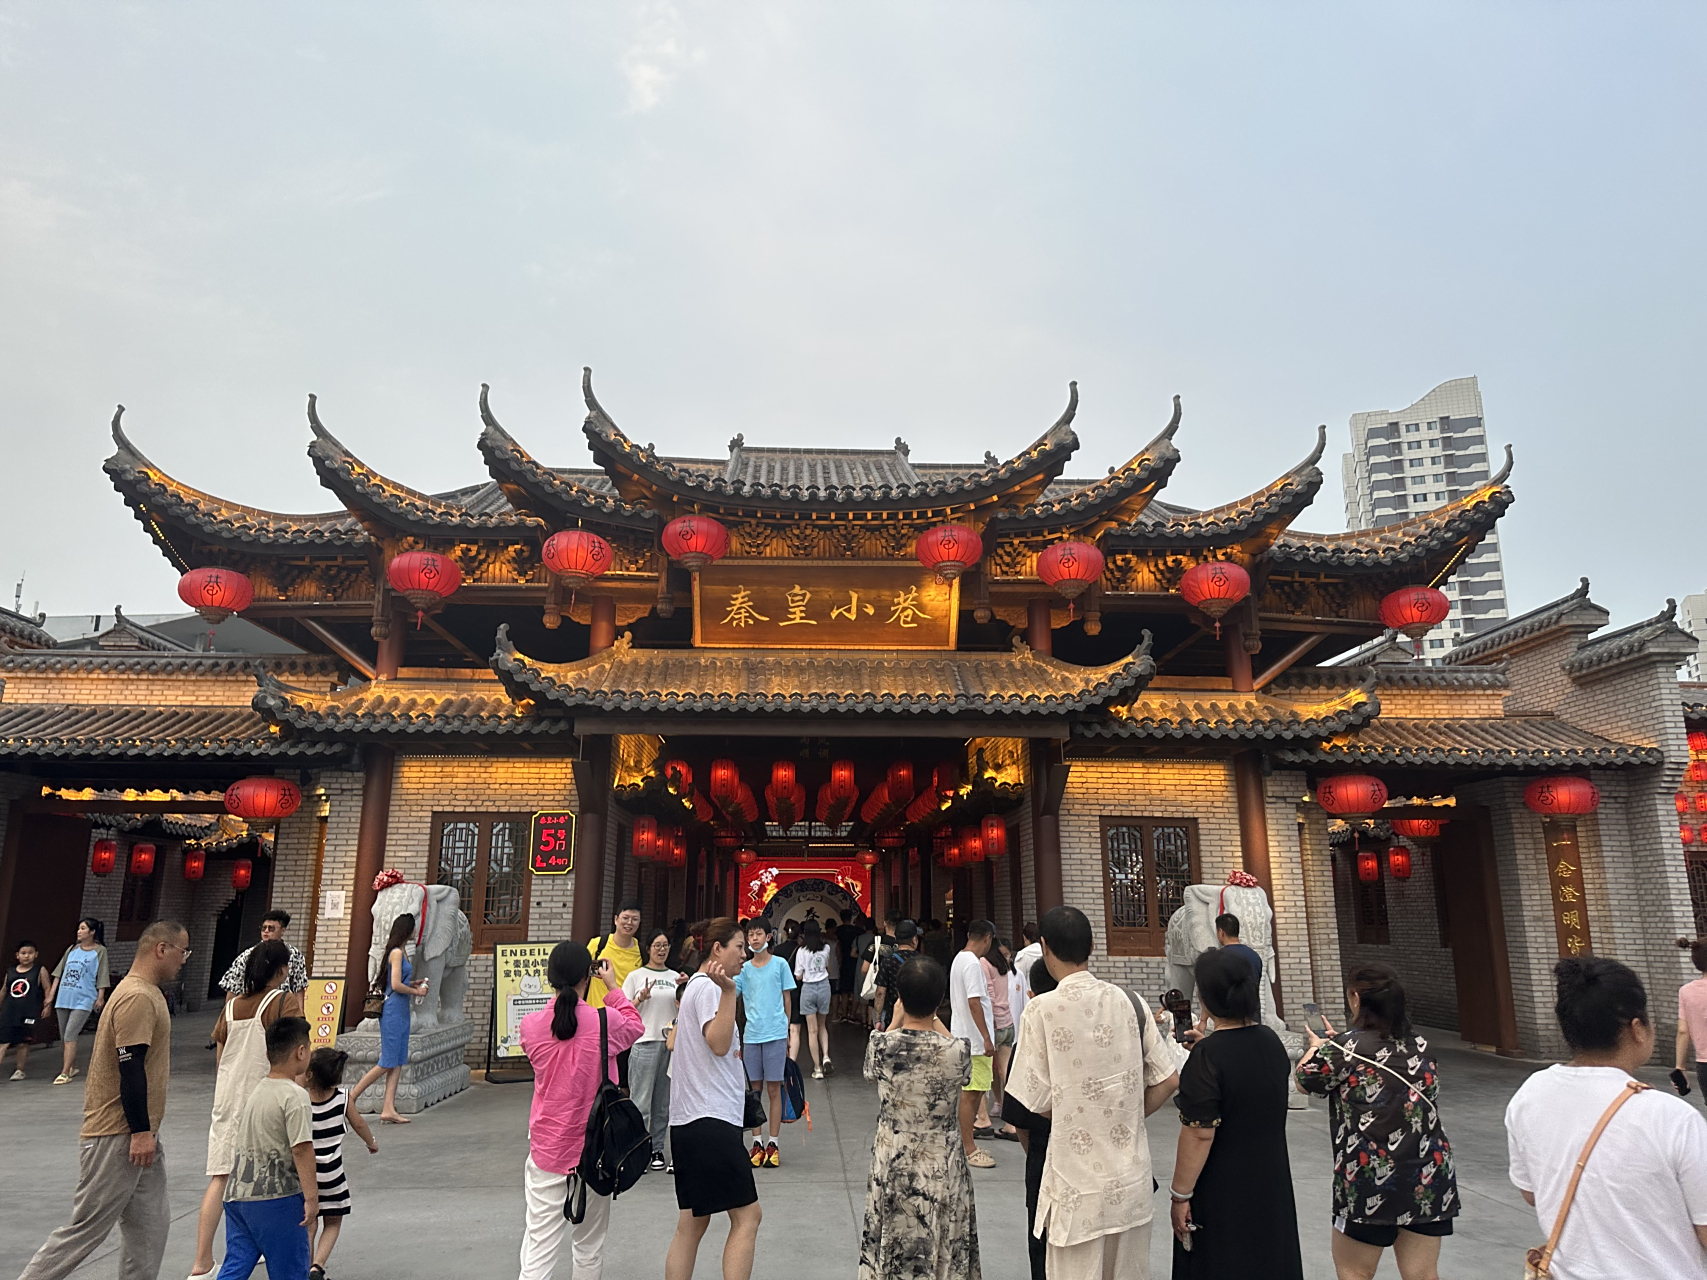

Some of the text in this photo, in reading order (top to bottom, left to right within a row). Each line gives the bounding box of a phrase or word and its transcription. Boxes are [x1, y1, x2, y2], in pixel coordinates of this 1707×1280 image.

[719, 584, 932, 629] 秦皇小巷
[1366, 1194, 1381, 1208] NIKE
